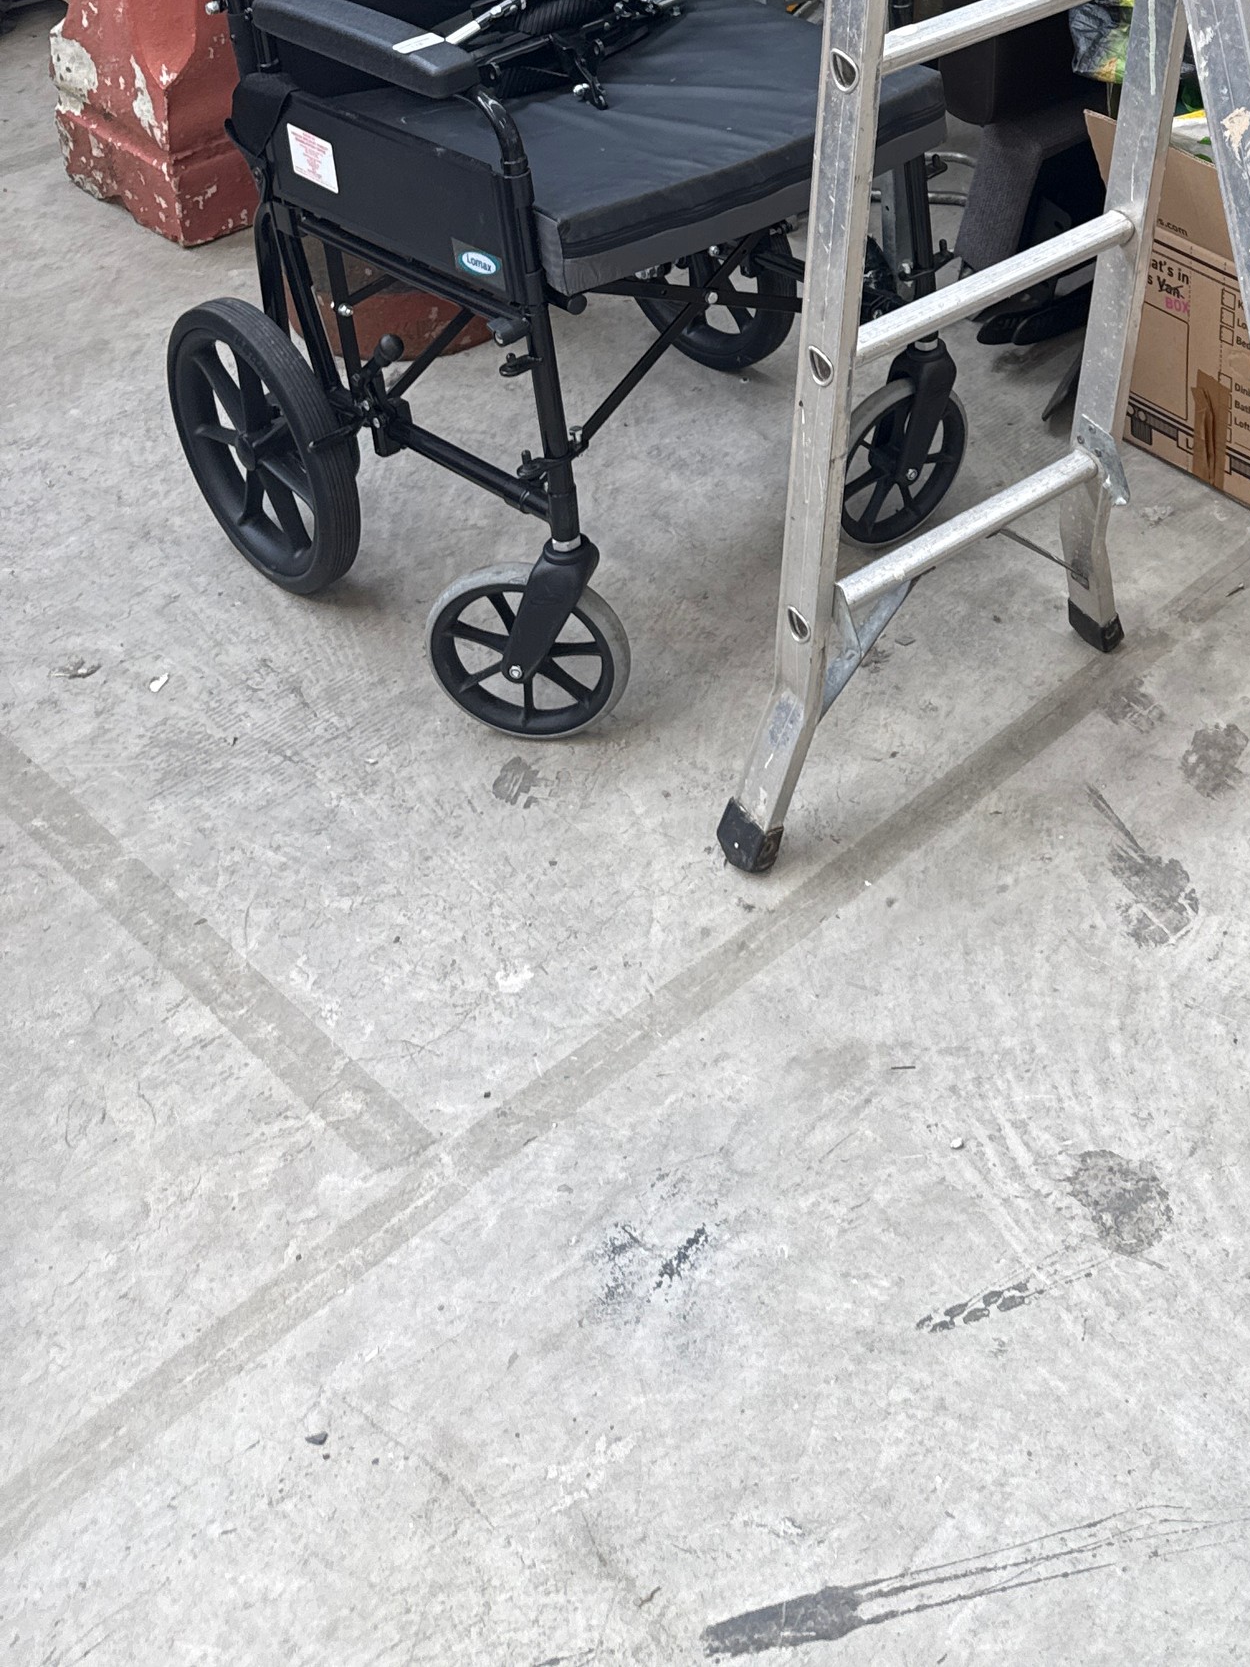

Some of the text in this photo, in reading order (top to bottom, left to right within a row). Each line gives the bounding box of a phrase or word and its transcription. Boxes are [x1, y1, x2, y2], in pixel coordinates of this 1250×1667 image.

[466, 253, 492, 272] Lomax
[1151, 259, 1190, 285] at's in
[1165, 296, 1190, 313] BOX
